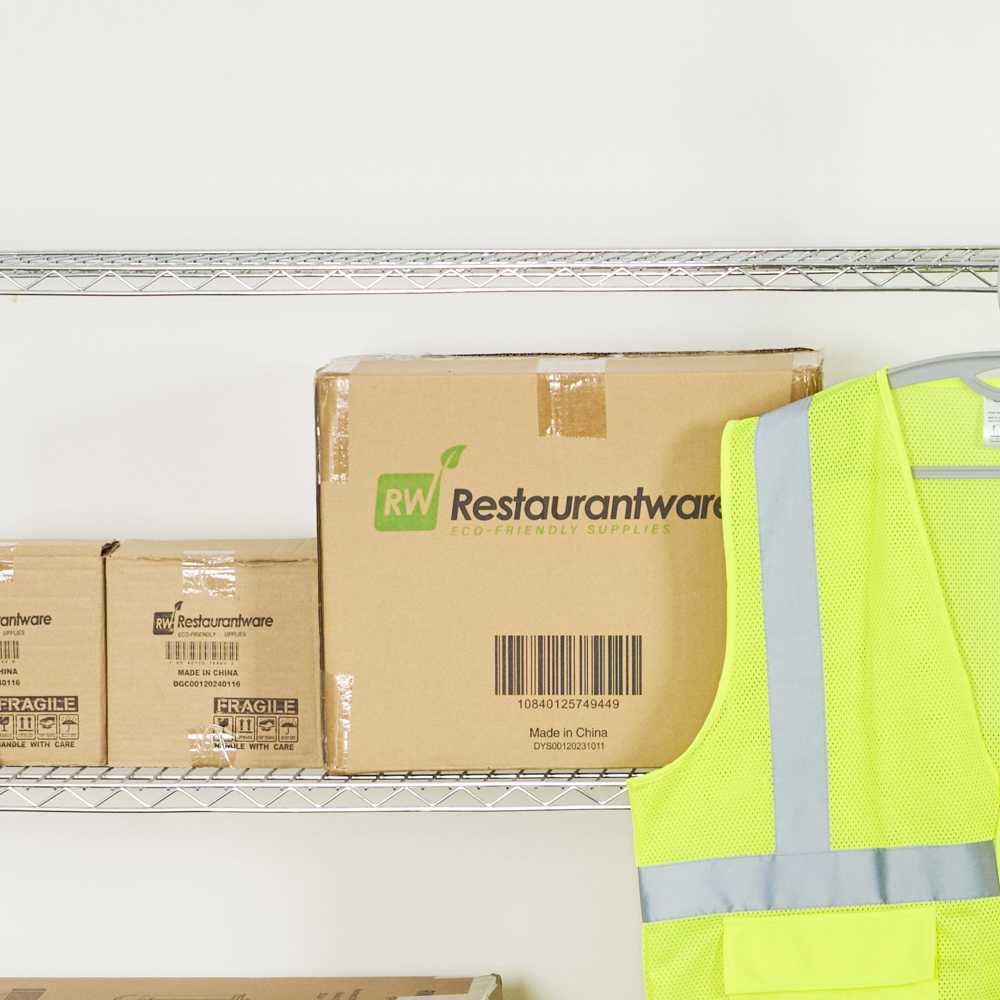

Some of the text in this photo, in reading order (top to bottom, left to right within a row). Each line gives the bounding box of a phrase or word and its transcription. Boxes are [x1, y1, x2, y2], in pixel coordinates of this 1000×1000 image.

[383, 487, 432, 517] RW
[450, 524, 671, 536] ECO-FRIENDLY SUPPLIES
[155, 617, 172, 629] RW
[177, 614, 274, 628] Restaurantware
[0, 697, 77, 712] FRAGILE
[217, 698, 296, 713] FRAGILE
[518, 699, 620, 709] 10840125749449
[529, 727, 608, 738] Made in China
[273, 743, 294, 751] CARE
